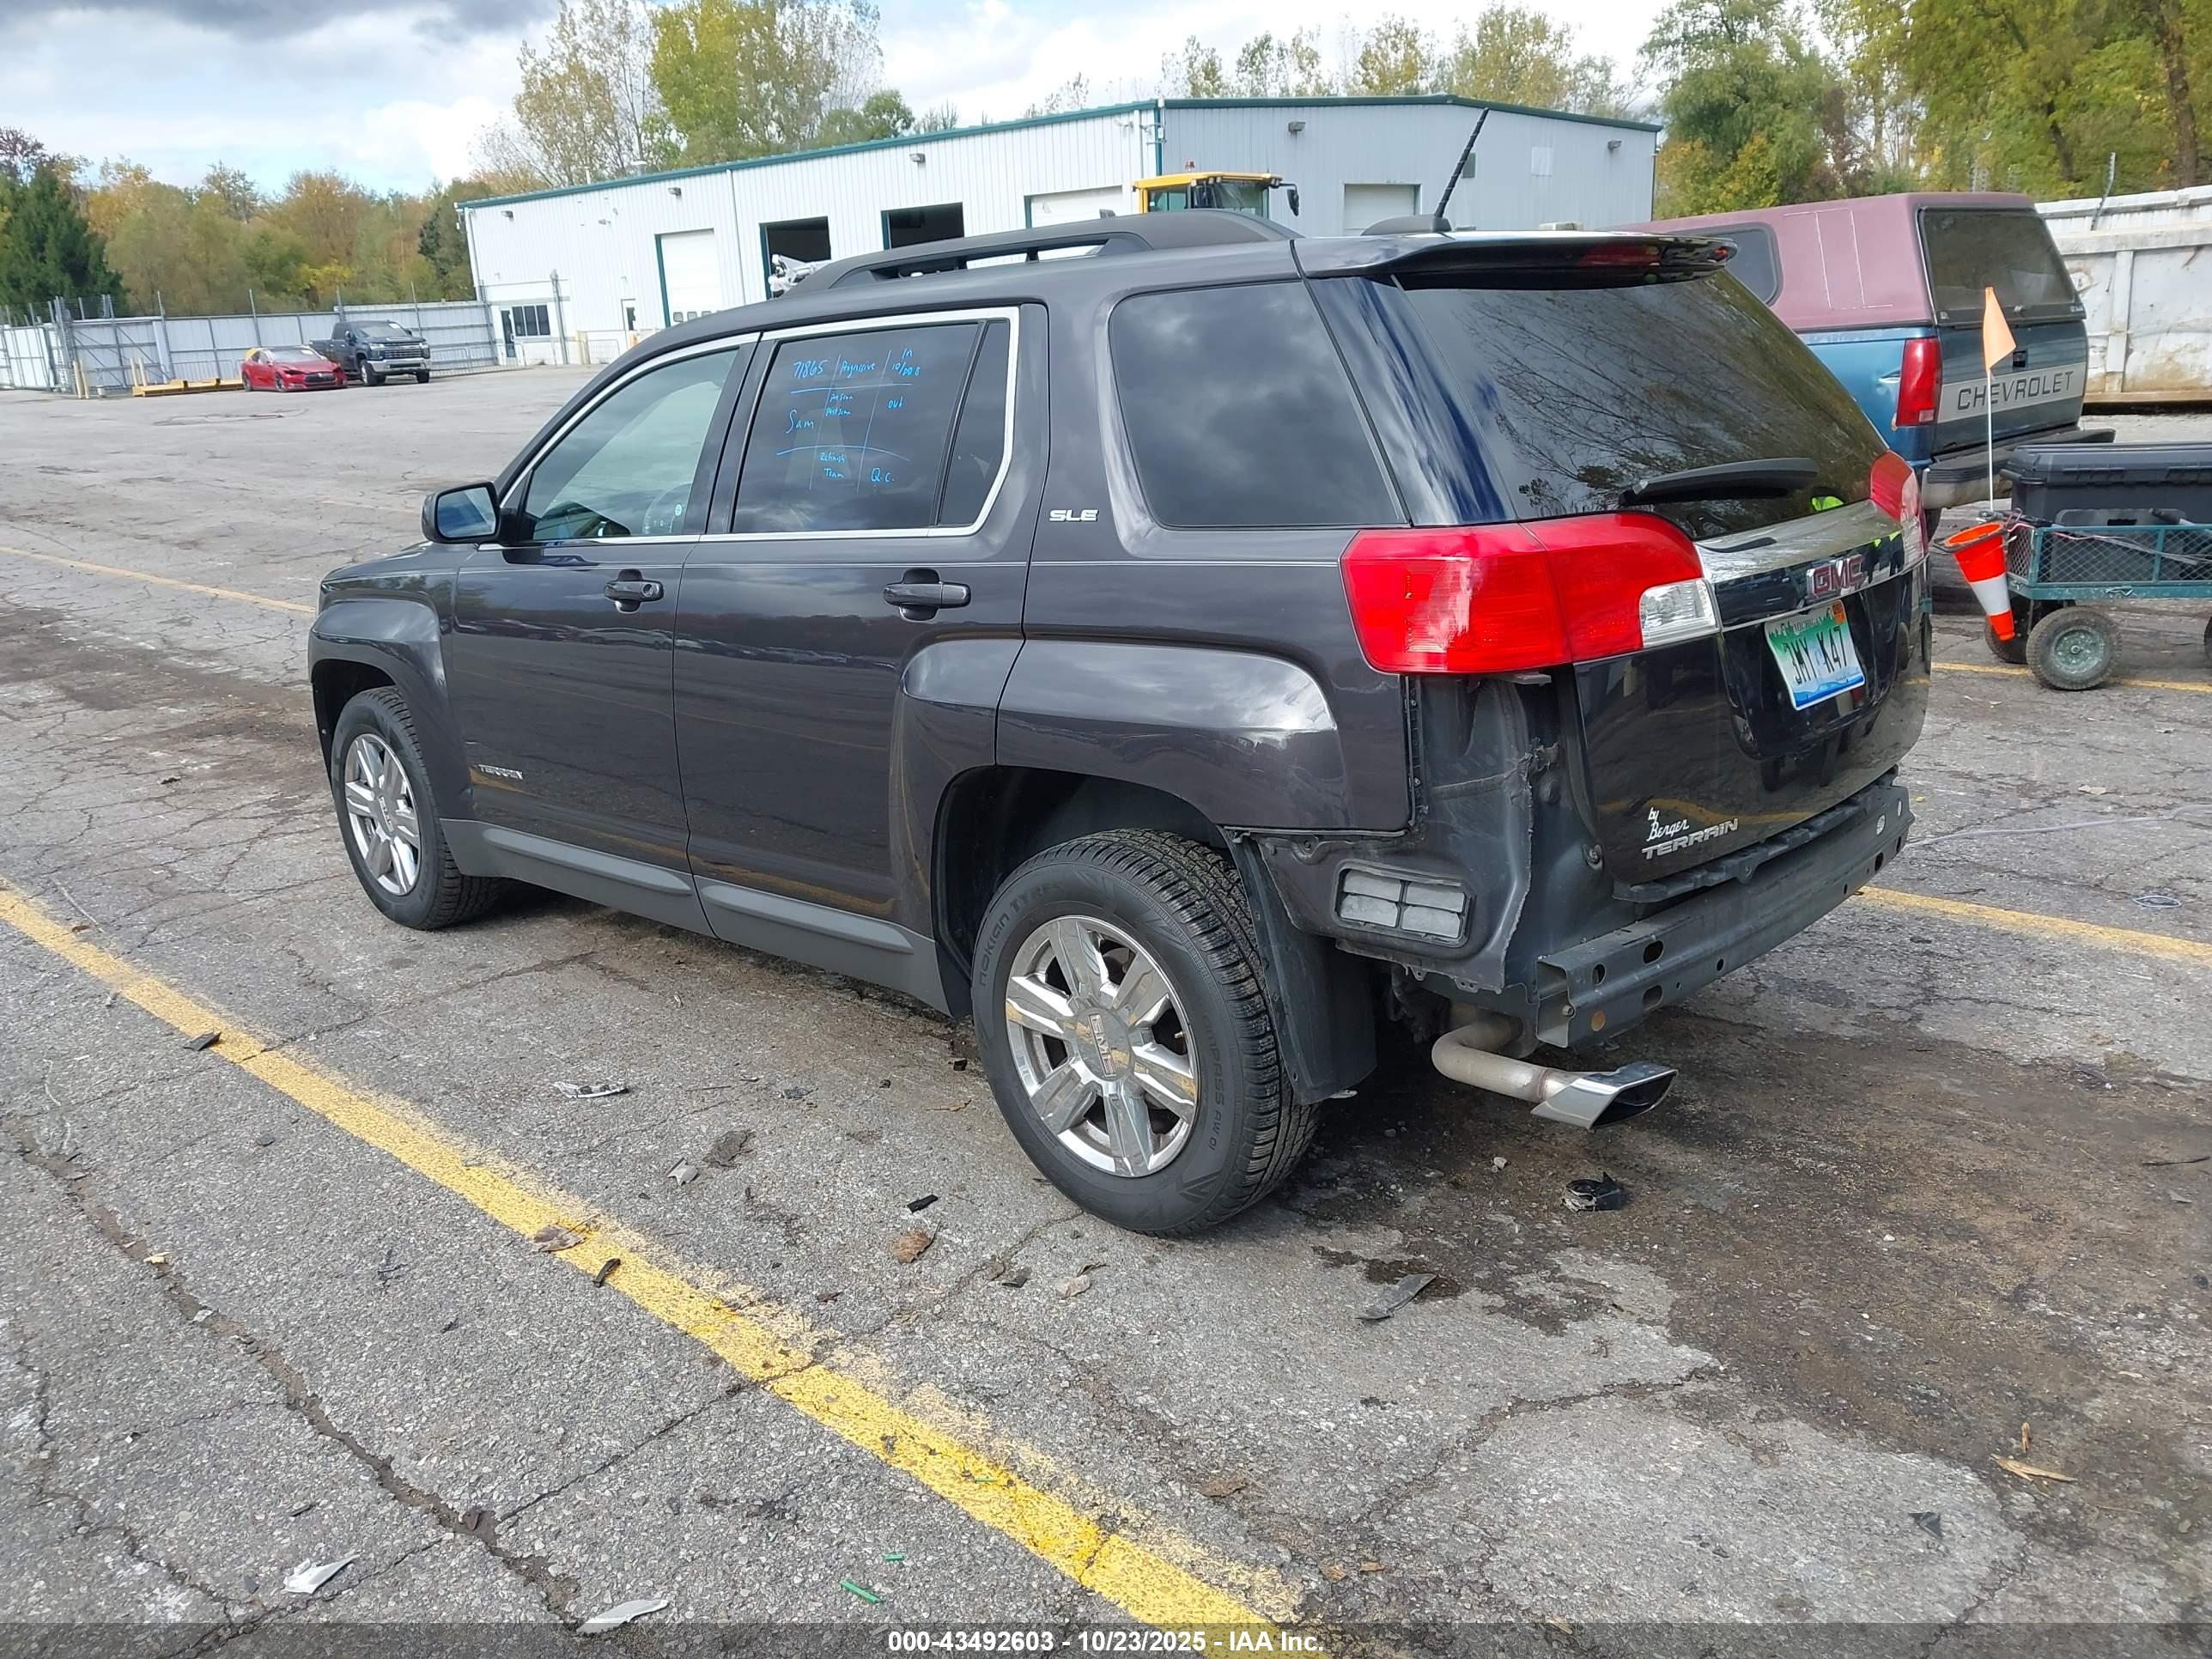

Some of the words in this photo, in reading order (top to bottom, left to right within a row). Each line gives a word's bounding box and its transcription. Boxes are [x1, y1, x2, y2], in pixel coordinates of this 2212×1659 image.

[1957, 370, 2075, 411] CHEVROLET
[1048, 509, 1099, 522] SLE
[1808, 554, 1865, 597] GMC
[1816, 626, 1848, 674] K47
[1645, 819, 1691, 842] Berger
[1648, 806, 1660, 823] by
[1641, 817, 1740, 860] TERRAIN
